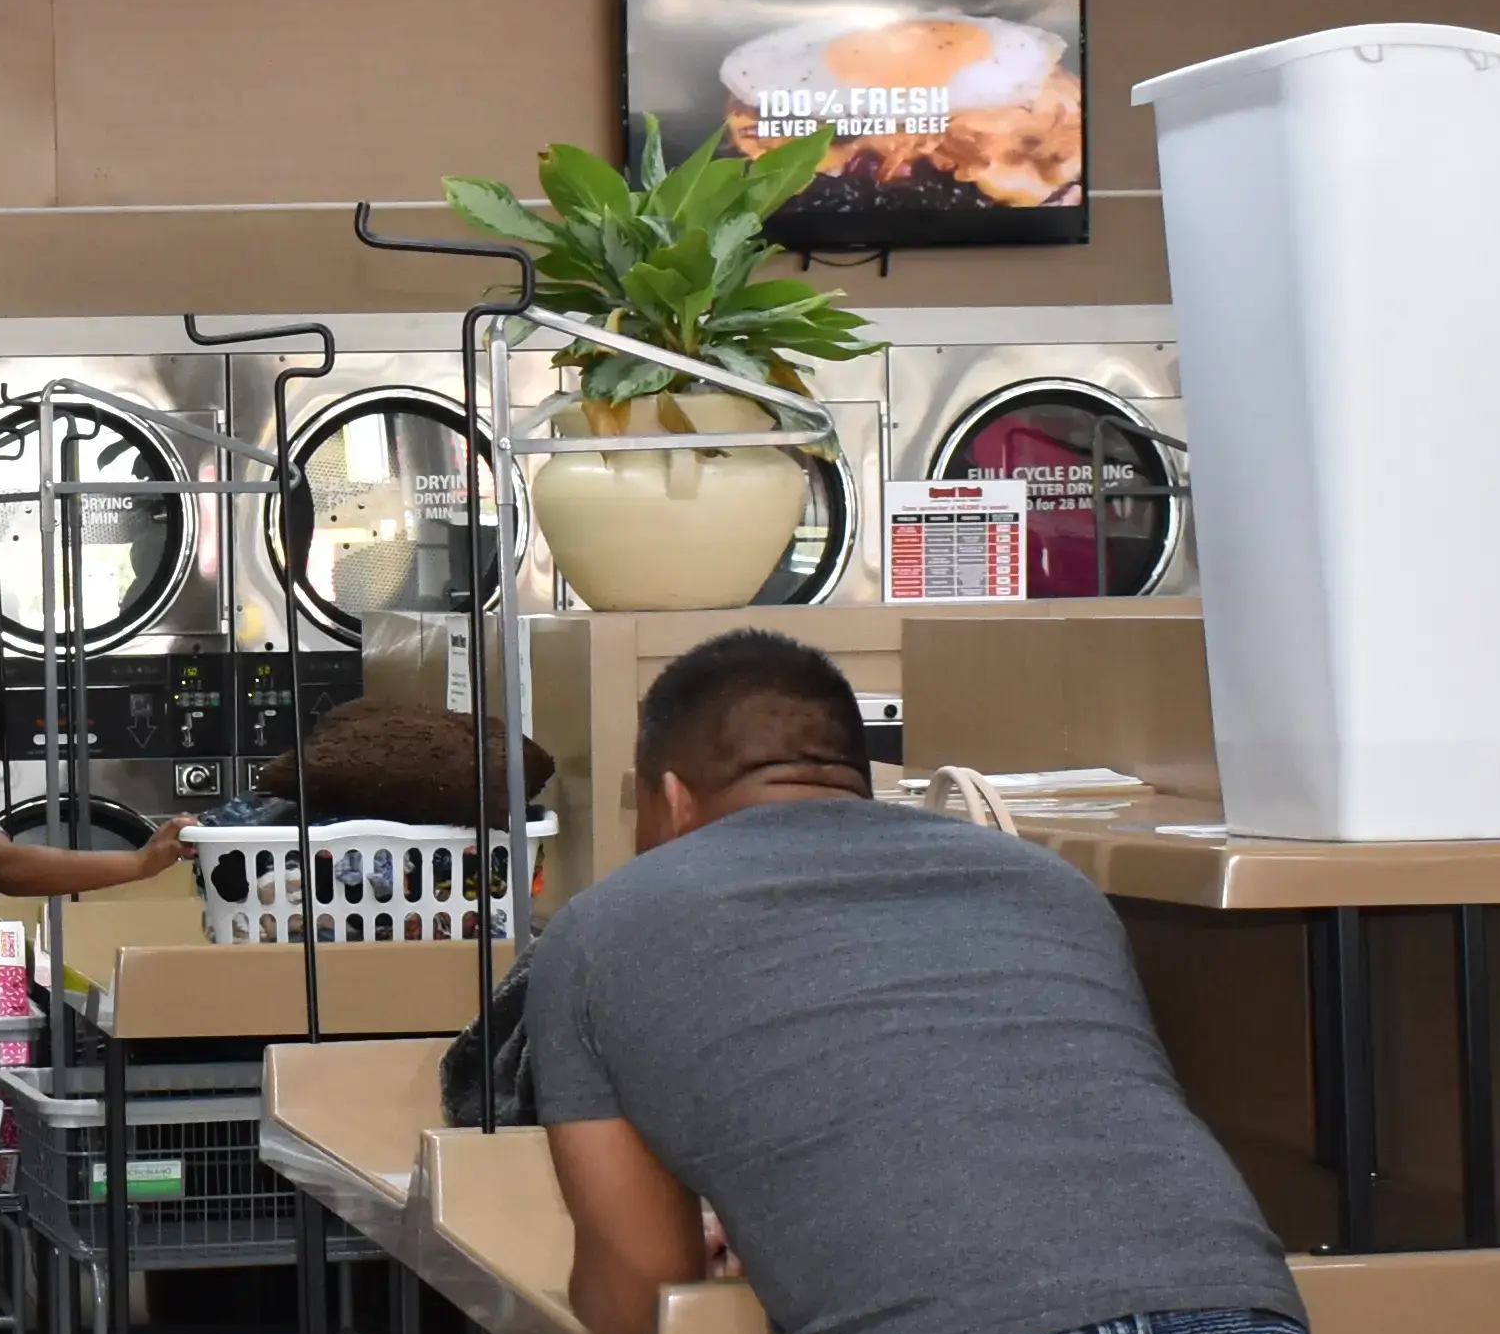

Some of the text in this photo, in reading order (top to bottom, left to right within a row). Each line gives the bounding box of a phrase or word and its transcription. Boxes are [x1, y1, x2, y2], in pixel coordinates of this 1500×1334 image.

[757, 86, 949, 117] 100% FRESH
[757, 116, 950, 137] NEVER ROZEN BEEF
[1012, 466, 1065, 481] CYCLE
[1068, 464, 1134, 481] DRING
[415, 475, 468, 491] DRYIN
[1025, 483, 1065, 496] ETTER
[414, 493, 468, 505] DRYING
[1036, 497, 1055, 510] for
[1058, 497, 1076, 511] 28
